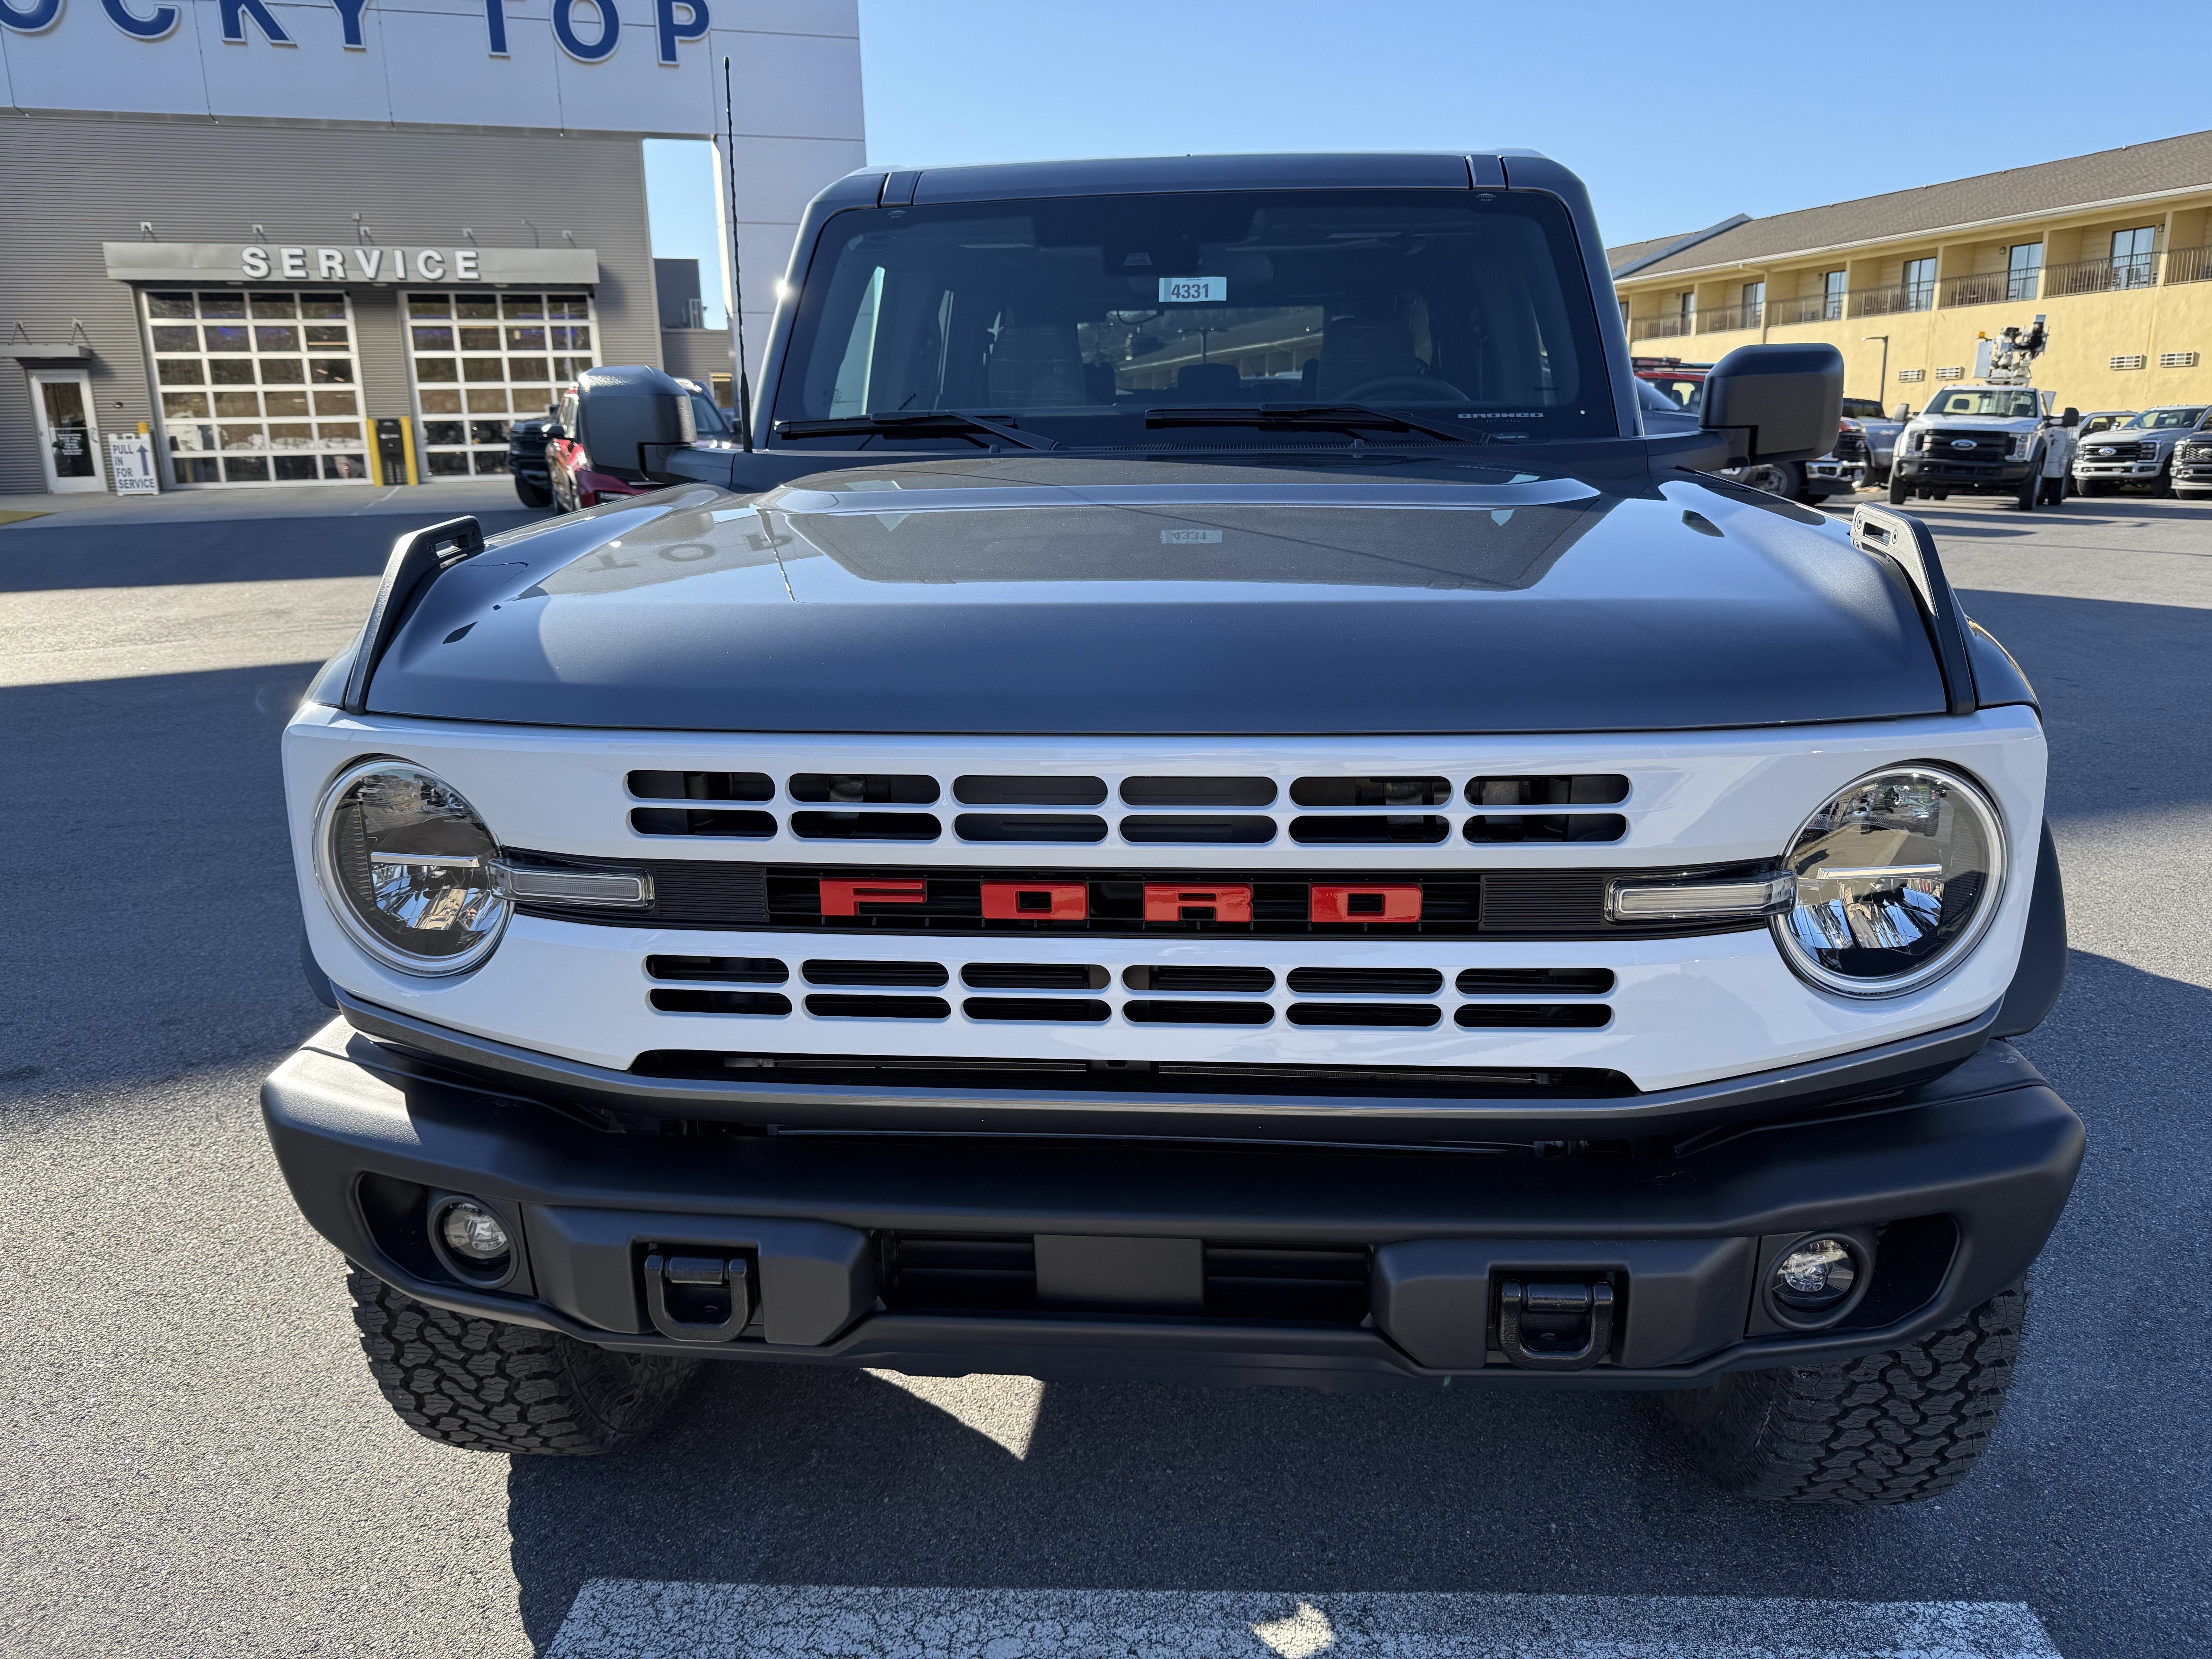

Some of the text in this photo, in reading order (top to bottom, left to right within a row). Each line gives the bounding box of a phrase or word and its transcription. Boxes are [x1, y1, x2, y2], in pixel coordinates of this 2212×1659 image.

[241, 246, 481, 280] SERVICE
[1171, 283, 1209, 299] 4331
[112, 444, 134, 454] PULL
[114, 456, 124, 466] IN
[116, 467, 134, 477] FOR
[118, 478, 155, 489] SERVICE
[819, 878, 1423, 923] FORD
